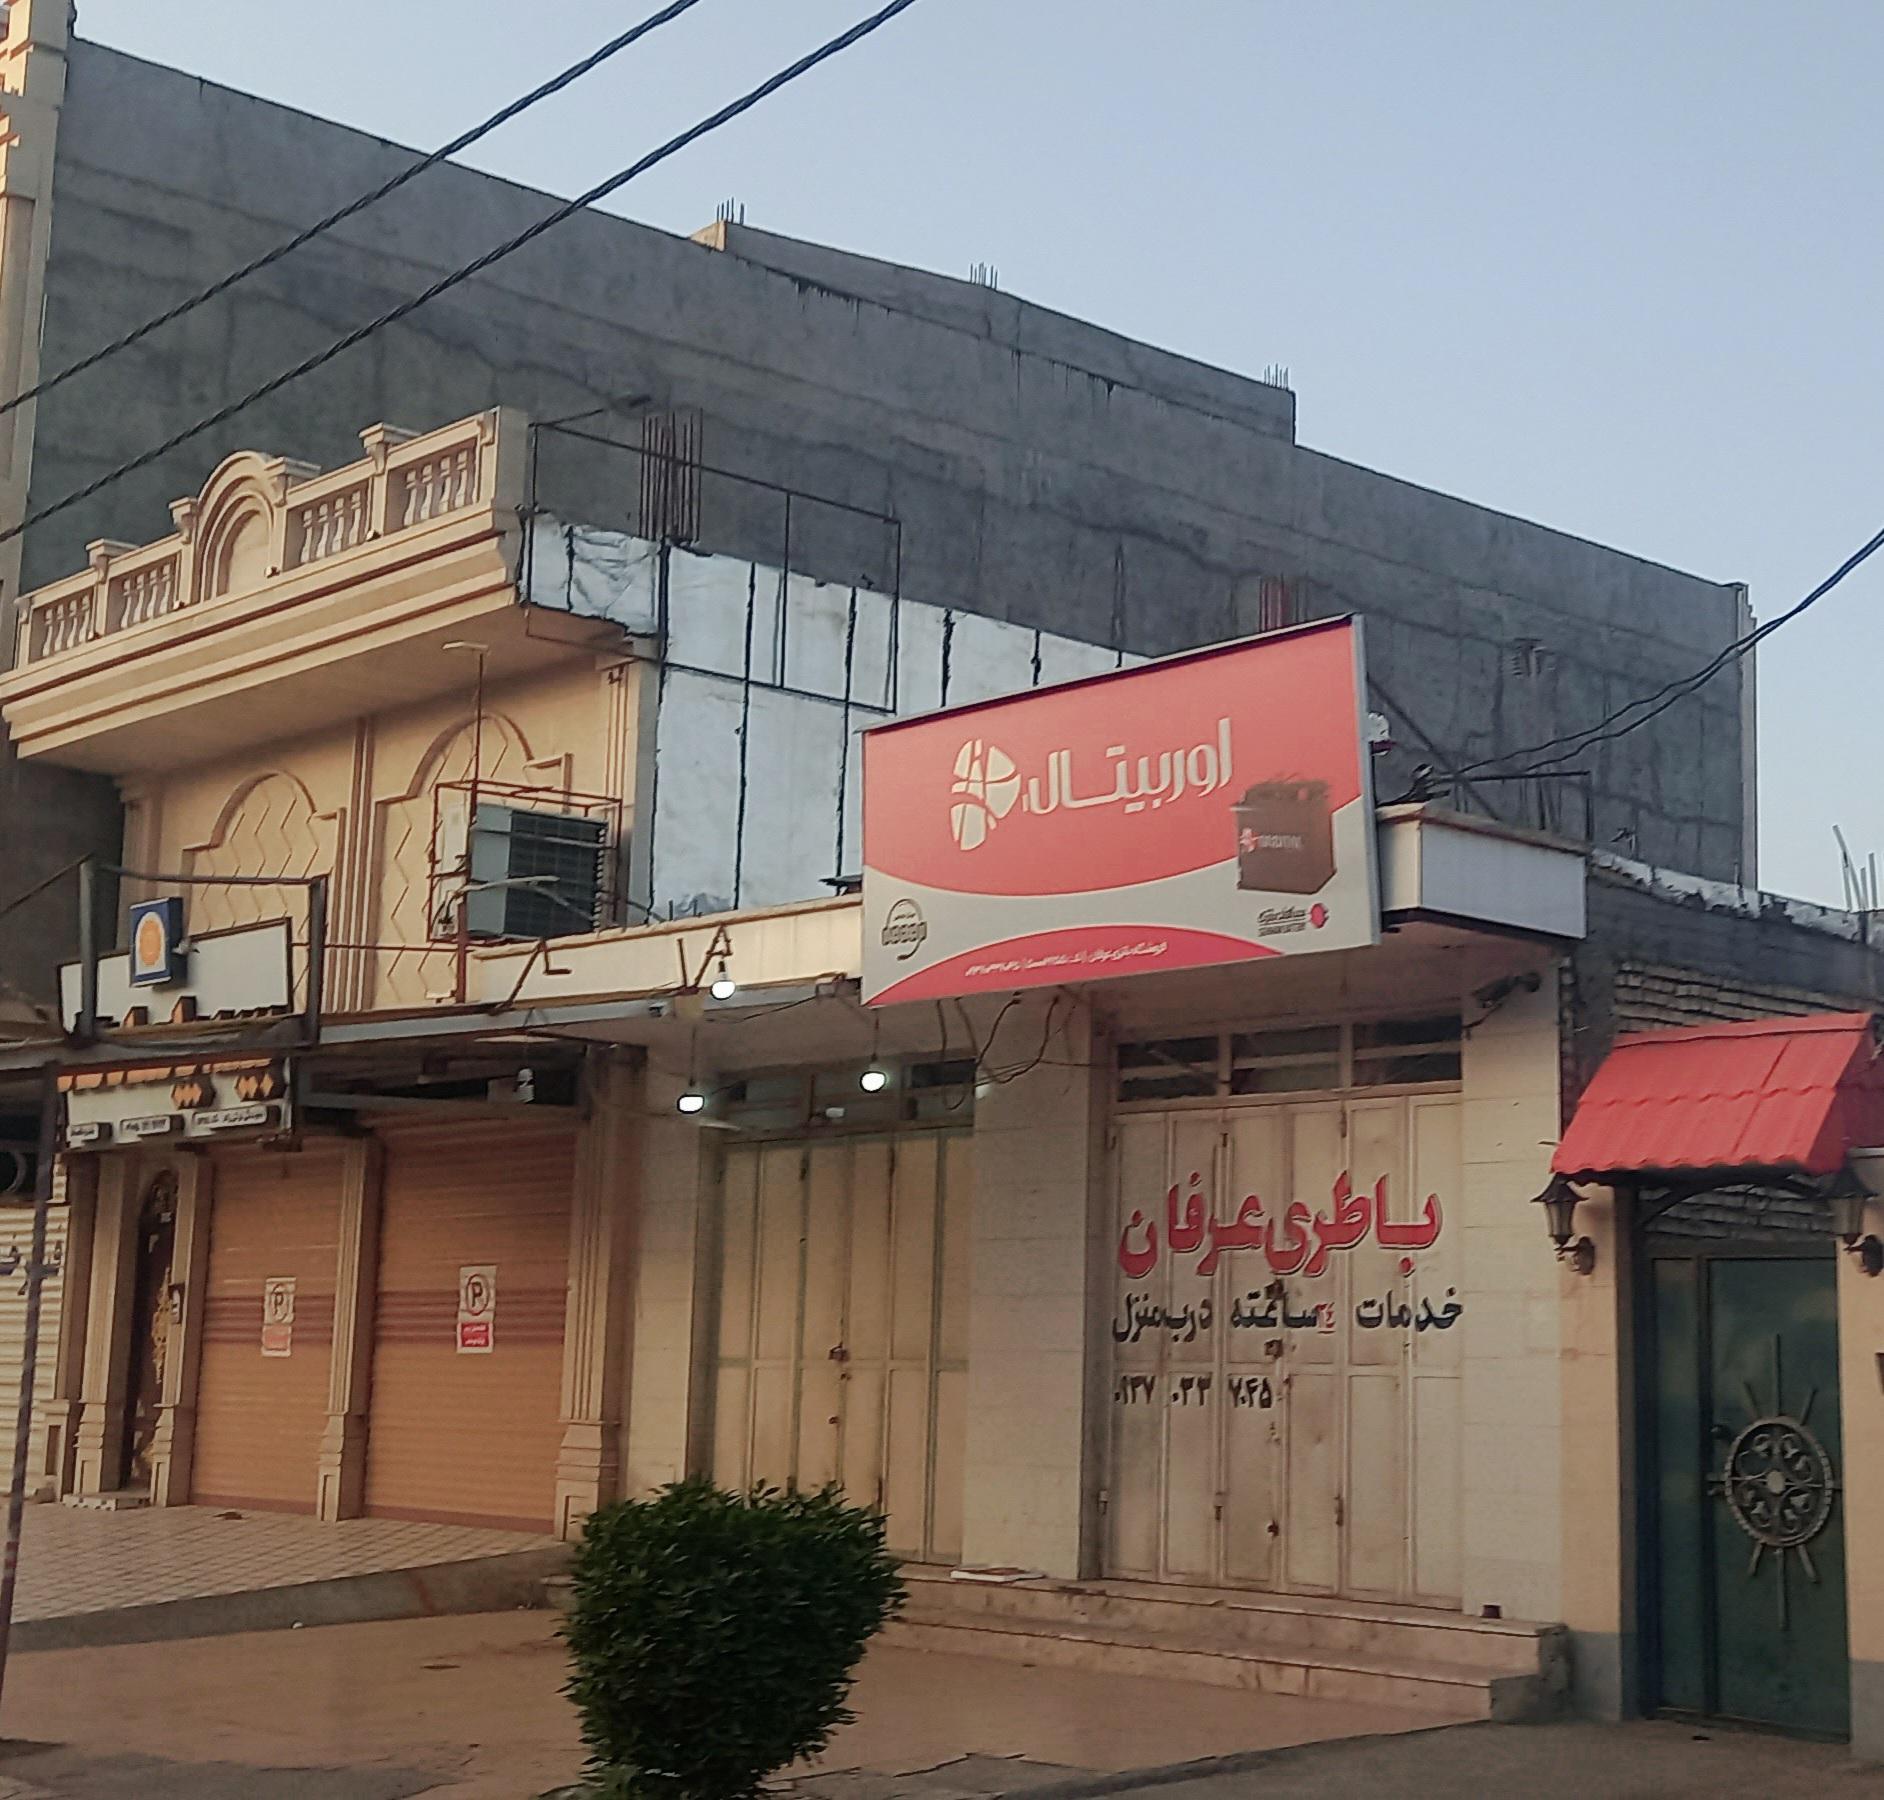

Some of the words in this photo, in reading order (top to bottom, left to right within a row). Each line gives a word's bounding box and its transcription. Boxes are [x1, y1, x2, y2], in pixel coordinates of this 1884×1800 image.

[1022, 716, 1233, 815] اوربیتال
[1118, 1170, 1265, 1278] عرفان
[1264, 1169, 1443, 1277] باطری
[1355, 1286, 1464, 1332] خدمات
